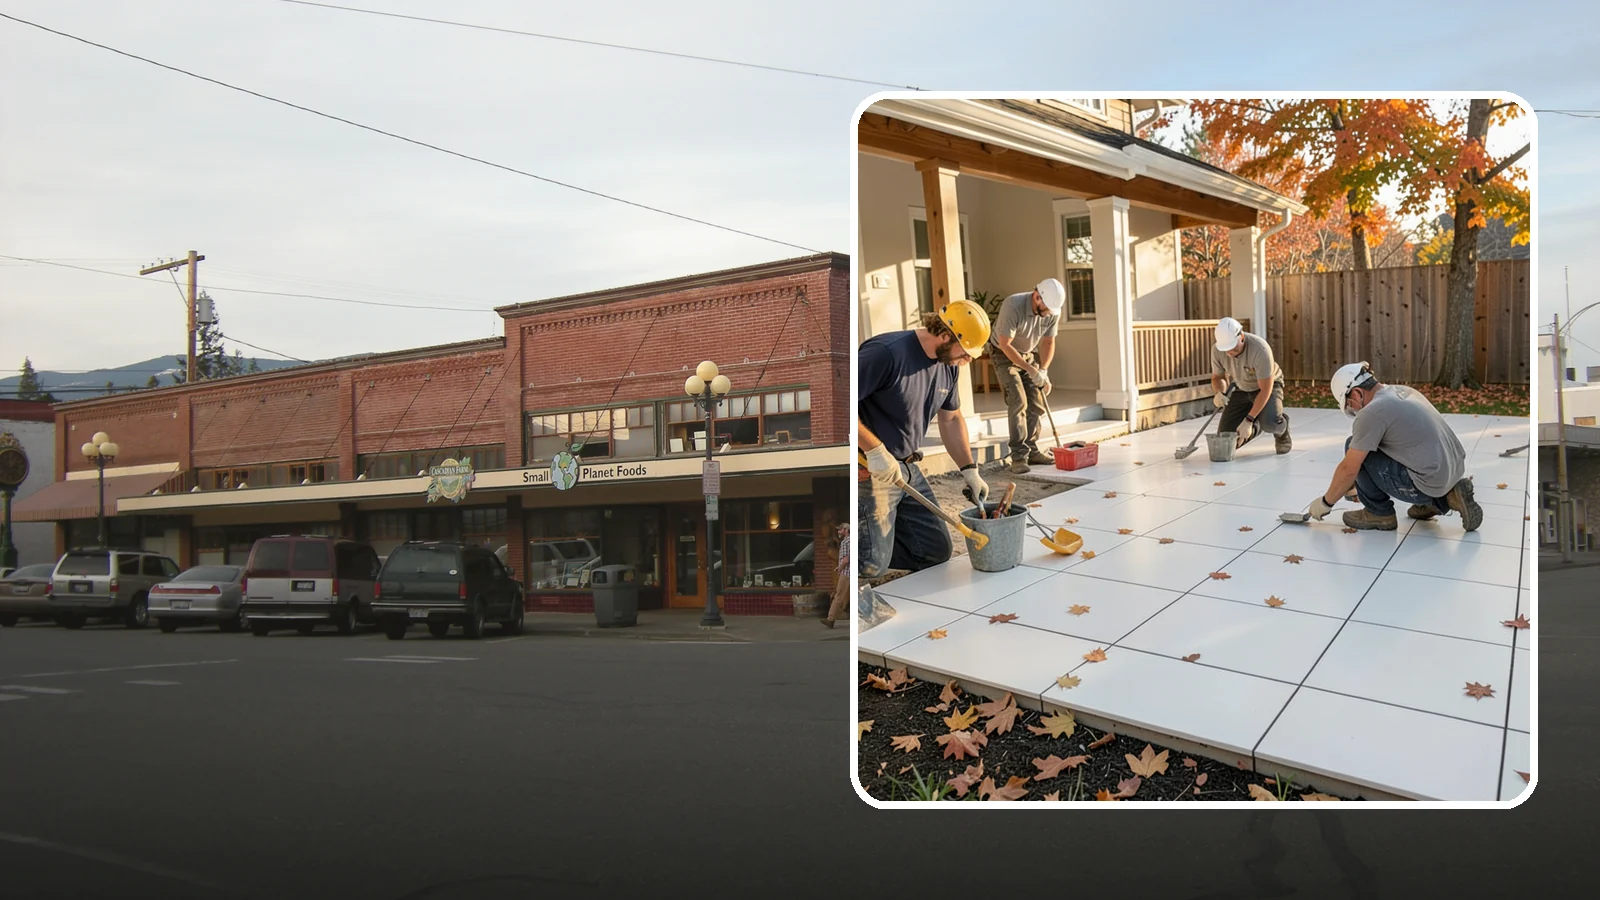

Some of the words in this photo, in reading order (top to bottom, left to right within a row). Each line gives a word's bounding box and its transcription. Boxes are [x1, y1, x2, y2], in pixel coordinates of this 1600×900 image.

[523, 471, 549, 483] Small
[583, 467, 614, 479] Planet
[617, 464, 647, 477] Foods
